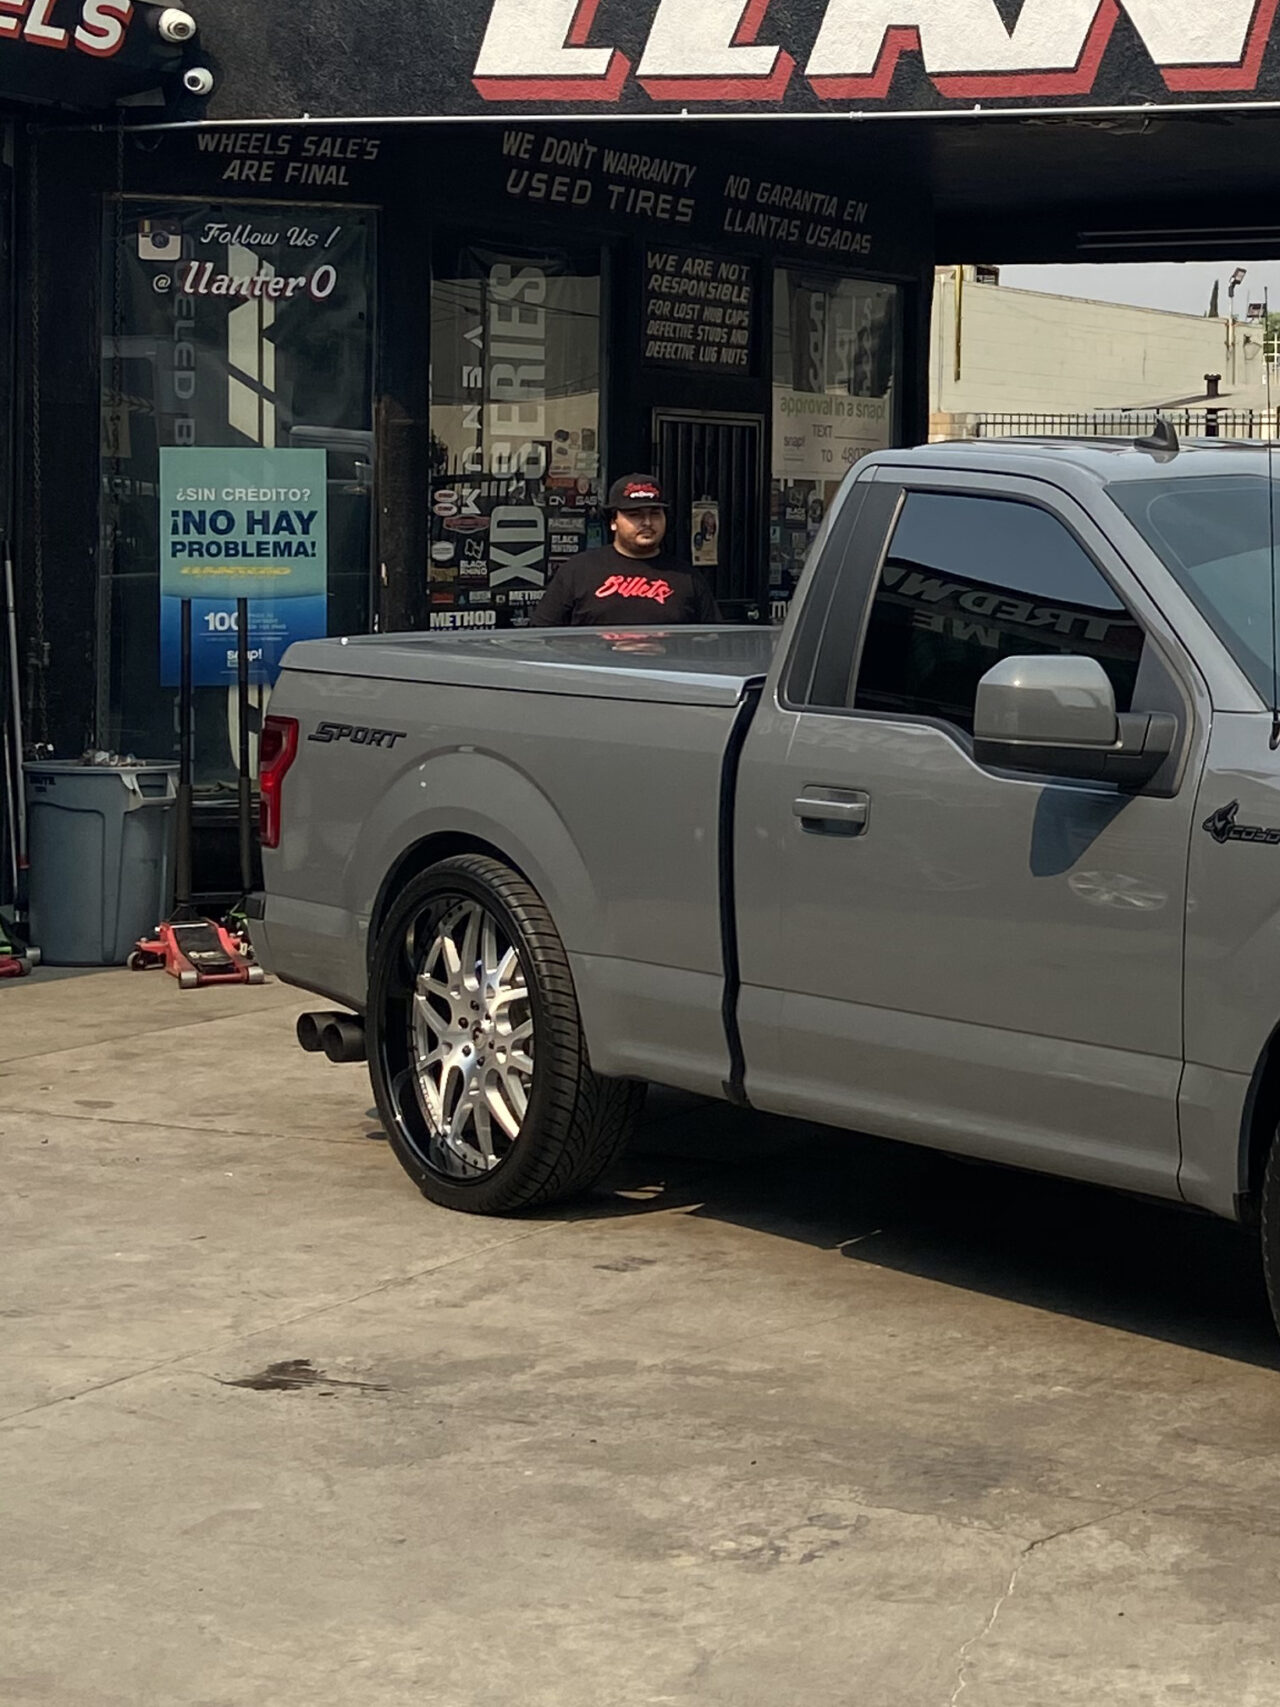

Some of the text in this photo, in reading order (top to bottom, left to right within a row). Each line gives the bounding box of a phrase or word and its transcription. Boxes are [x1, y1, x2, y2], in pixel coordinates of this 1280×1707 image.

[197, 133, 381, 160] WHEELS SALE'S
[502, 130, 697, 188] WE DON'T WARRANTY
[222, 159, 350, 186] ARE FINAL
[506, 168, 696, 222] USED TIRES
[723, 174, 869, 224] NO GARANTIA EN
[200, 223, 279, 245] Follow
[723, 207, 873, 255] LLANTAS USADAS
[647, 251, 750, 280] WE ARE NOT
[647, 273, 750, 305] RESPONSIBLE
[648, 299, 750, 328] FOR LOST HUB CAPS
[646, 320, 749, 346] DEFECTIVE STUDS AND
[645, 340, 749, 366] DEFECTIVE LUG NUTS
[780, 396, 833, 417] approval
[812, 423, 833, 438] TEXT
[821, 448, 833, 463] TO
[176, 488, 216, 502] ¿SIN
[171, 509, 319, 536] ¡NO HAY
[171, 540, 317, 558] PROBLEMA!
[429, 610, 497, 629] METHOD
[307, 720, 408, 749] SPORT
